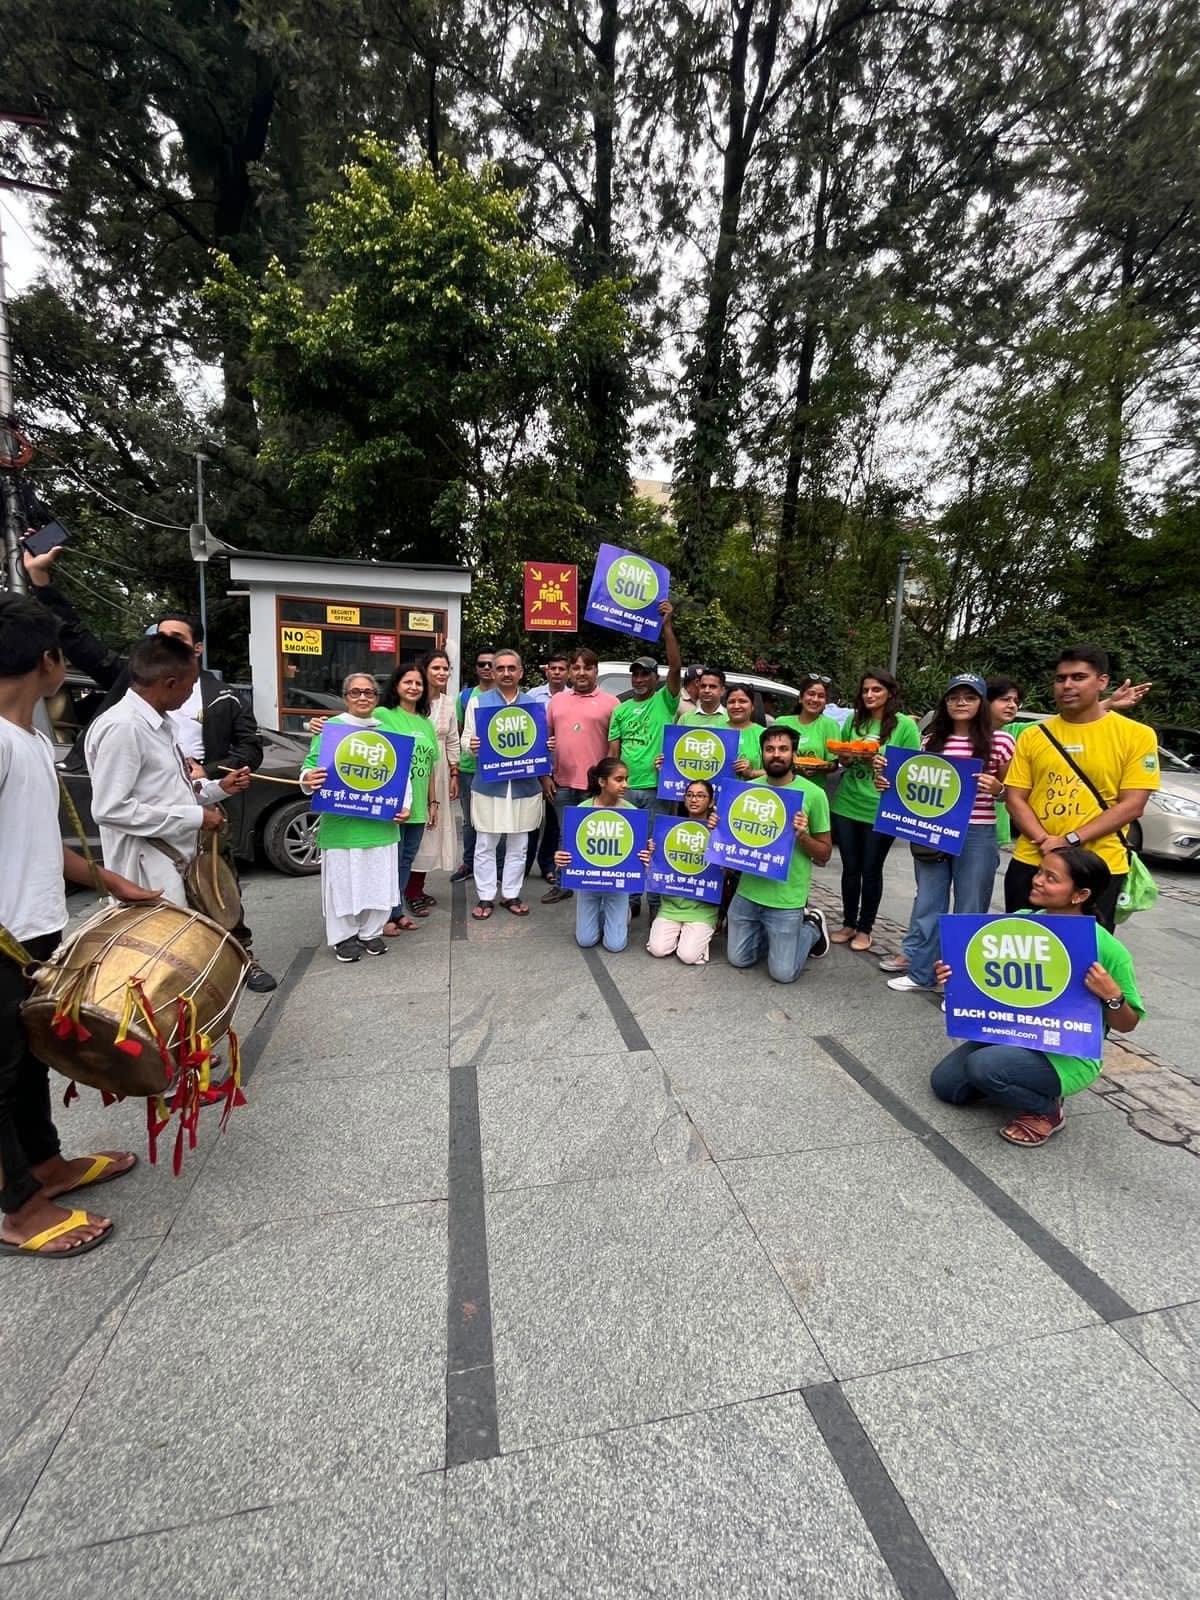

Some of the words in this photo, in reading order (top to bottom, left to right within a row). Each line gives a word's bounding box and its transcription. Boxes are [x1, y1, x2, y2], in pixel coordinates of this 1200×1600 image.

[618, 562, 651, 585] SAVE
[615, 578, 647, 601] SOIL
[592, 602, 609, 612] EACH
[609, 608, 623, 617] ONE
[624, 612, 644, 623] REACH
[645, 618, 658, 628] ONE
[284, 630, 303, 642] NO
[284, 644, 319, 653] SMOKING
[495, 715, 528, 732] SAVE
[497, 731, 528, 749] SOIL
[685, 737, 717, 759] मिट्टी
[348, 738, 388, 766] मिट्टी
[340, 761, 389, 782] बचाओ
[483, 762, 500, 770] EACH
[500, 760, 513, 768] ONE
[514, 759, 534, 767] REACH
[678, 756, 719, 772] बचाओ
[906, 763, 951, 788] SAVE
[906, 783, 945, 809] SOIL
[743, 795, 777, 822] मिट्टी
[587, 820, 625, 837] SAVE
[733, 817, 779, 839] बचाओ
[881, 810, 901, 822] EACH
[902, 816, 917, 825] ONE
[918, 820, 942, 833] REACH
[943, 828, 960, 838] ONE
[586, 838, 623, 856] SOIL
[676, 828, 705, 852] मिट्टी
[601, 870, 625, 878] REACH
[982, 934, 1051, 962] SAVE
[984, 961, 1053, 992] SOIL
[953, 1008, 986, 1019] EACH
[988, 1011, 1015, 1022] ONE
[1017, 1014, 1060, 1028] REACH
[1063, 1021, 1092, 1033] ONE
[982, 1025, 1038, 1040] savesoil.com
